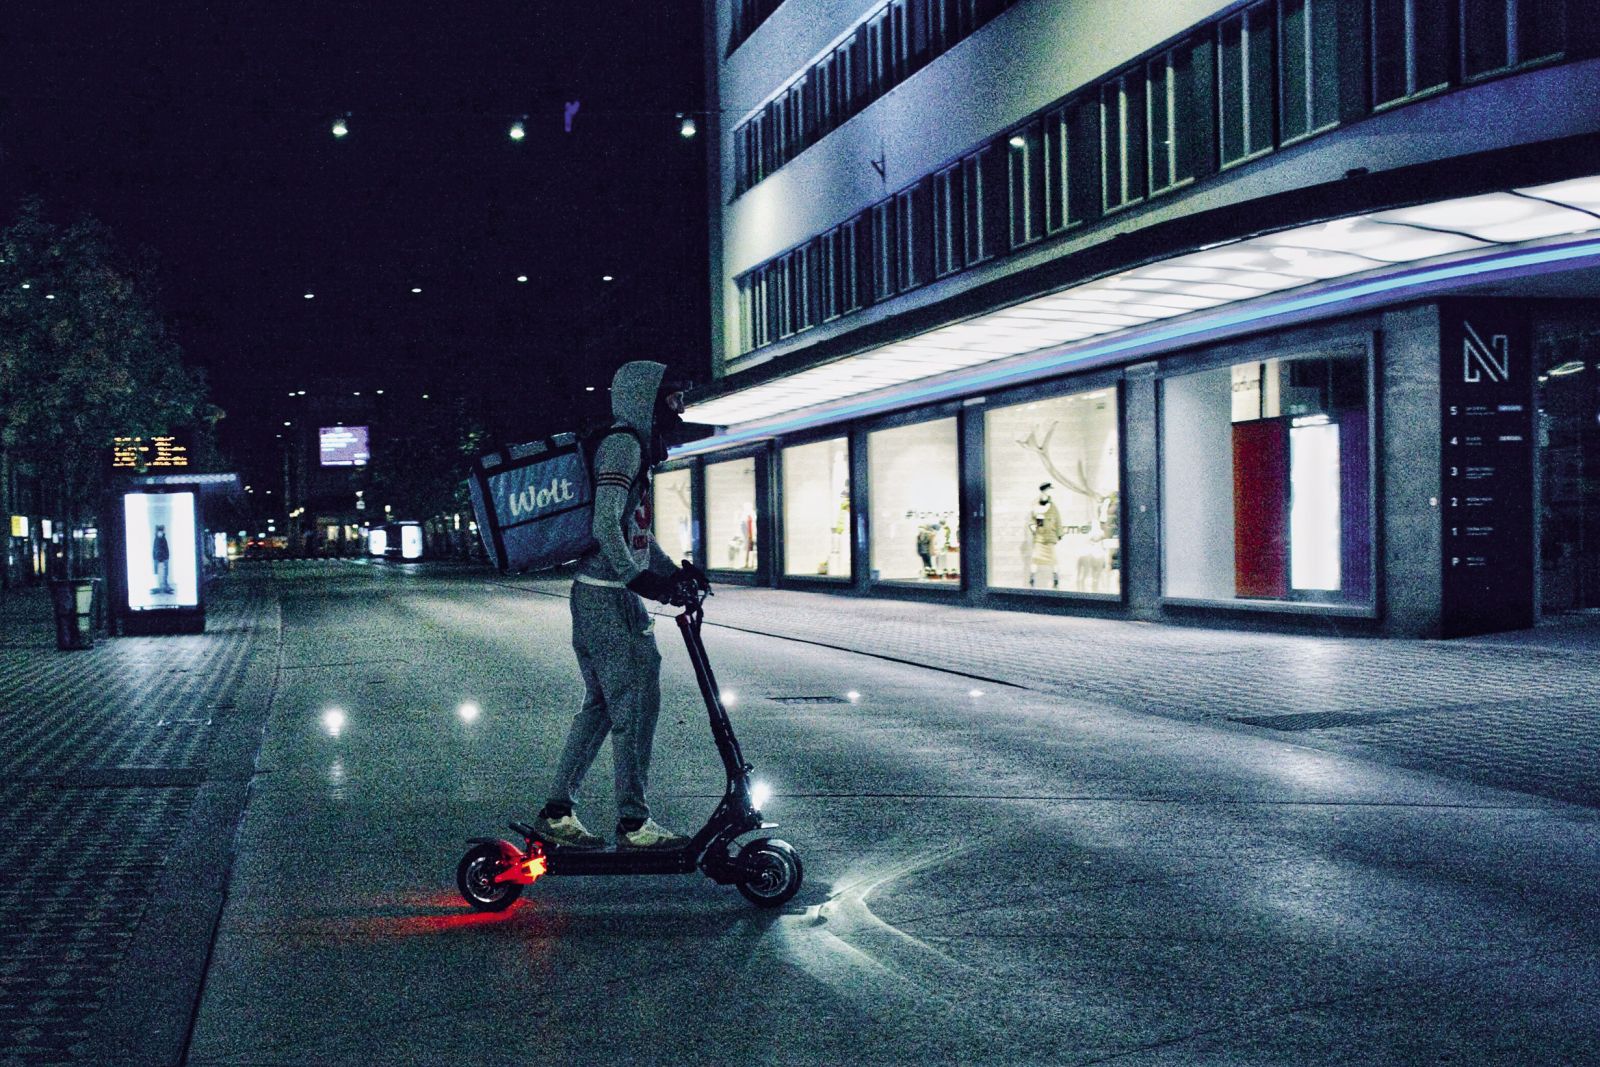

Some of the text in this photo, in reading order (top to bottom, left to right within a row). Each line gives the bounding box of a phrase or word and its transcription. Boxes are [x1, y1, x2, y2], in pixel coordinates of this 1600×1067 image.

[1450, 436, 1458, 446] 4
[1450, 466, 1458, 476] 3
[509, 478, 574, 516] Wolt
[1451, 497, 1458, 507] 2
[1451, 527, 1458, 536] 1
